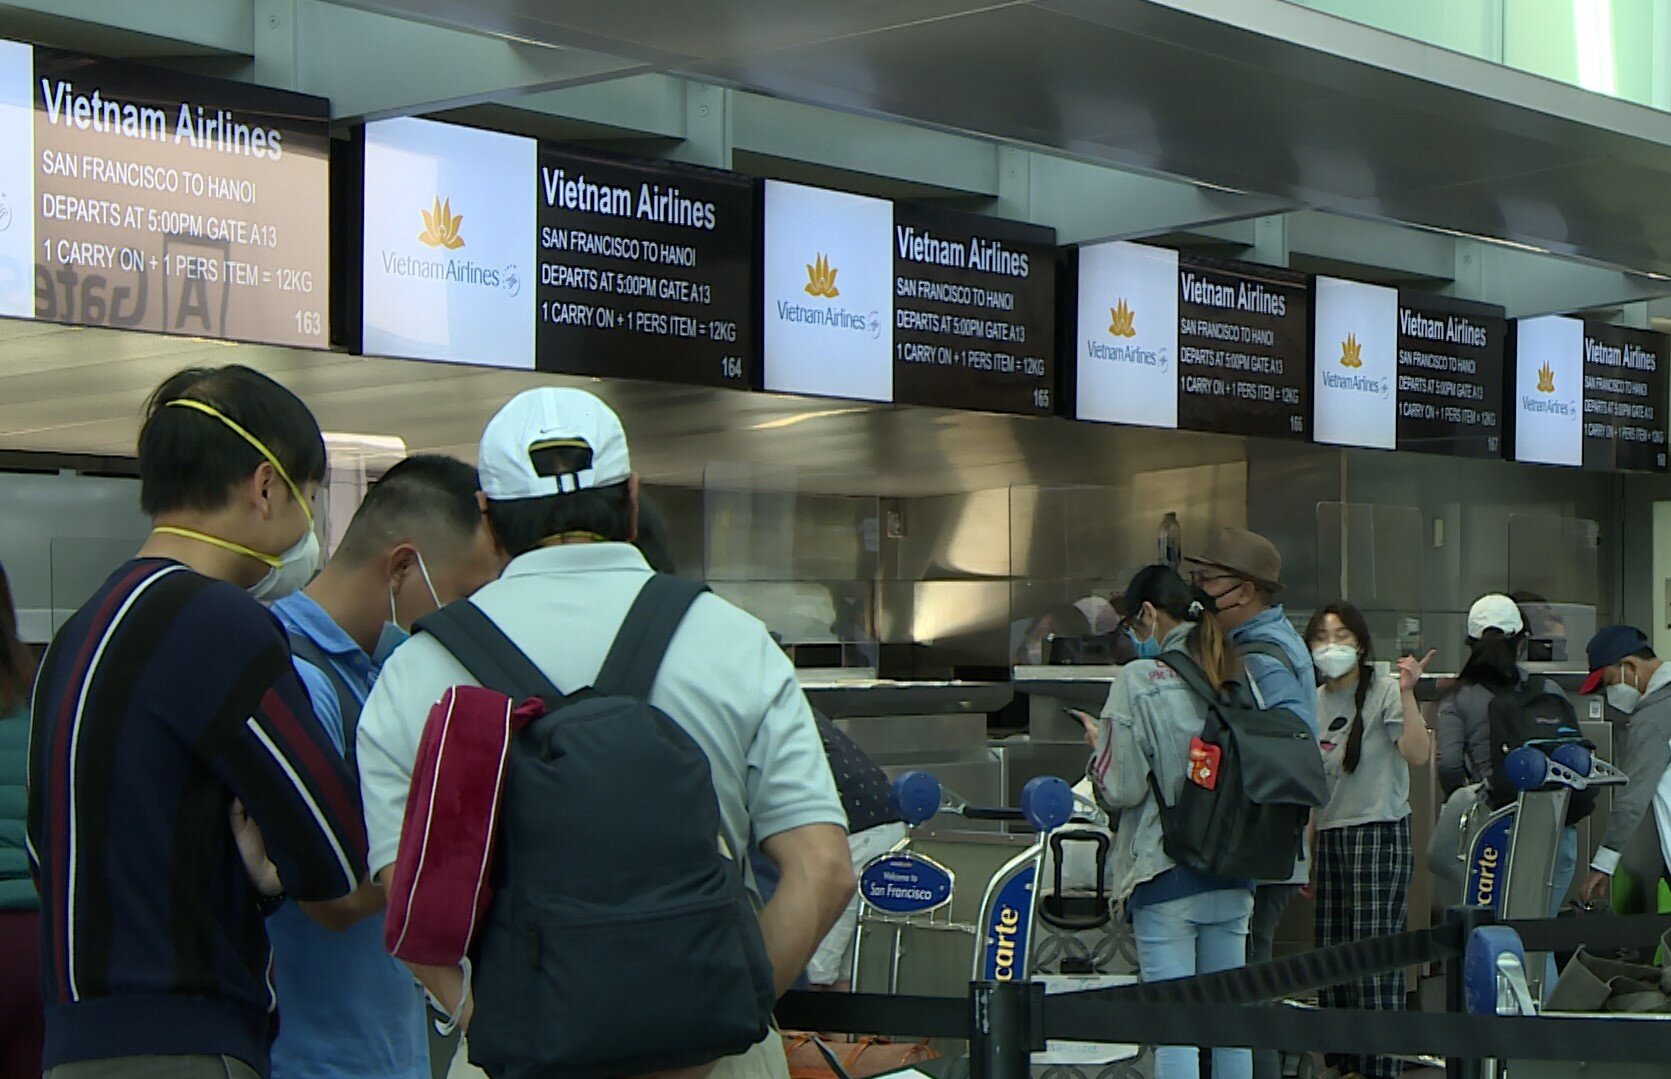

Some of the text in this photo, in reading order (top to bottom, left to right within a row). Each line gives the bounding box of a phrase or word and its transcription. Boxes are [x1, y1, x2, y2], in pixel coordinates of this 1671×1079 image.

[41, 78, 282, 160] Vietnam Airlines
[42, 149, 256, 204] SAN FRANCISCO TO HANOI
[541, 166, 716, 230] Vietnam Airlines
[43, 193, 277, 248] DEPARTS AT 5:00PM GATE A13
[44, 238, 313, 292] 1 CARRY ON + 1 PERS ITEM = 12KG
[542, 226, 696, 267] SAN FRANCISCO TO HANOI
[896, 225, 1028, 277] Vietnam Airlines
[541, 262, 711, 304] DEPARTS AT 5:00PM GATE A13
[897, 277, 1014, 310] SAN FRANCISCO TO HANOI
[1181, 272, 1286, 316] Vietnam Airlines
[294, 309, 321, 336] 163
[541, 301, 548, 322] 1
[551, 302, 594, 326] CARRY
[596, 308, 614, 328] ON
[626, 311, 633, 330] 1
[636, 312, 667, 334] PERS
[670, 315, 697, 337] ITEM
[709, 321, 737, 342] 12KG
[896, 309, 939, 332] DEPARTS
[940, 314, 952, 333] AT
[985, 321, 1008, 340] GATE
[1009, 325, 1025, 342] A13
[1181, 317, 1196, 335] SAN
[1197, 321, 1239, 342] FRANCISCO
[1240, 326, 1250, 343] TO
[1400, 307, 1486, 347] Vietnam Airlines
[721, 356, 742, 378] 164
[897, 342, 902, 361] 1
[904, 343, 936, 363] CARRY
[938, 347, 951, 366] ON
[968, 351, 992, 370] PERS
[993, 353, 1014, 372] ITEM
[870, 882, 932, 900] San Francisco
